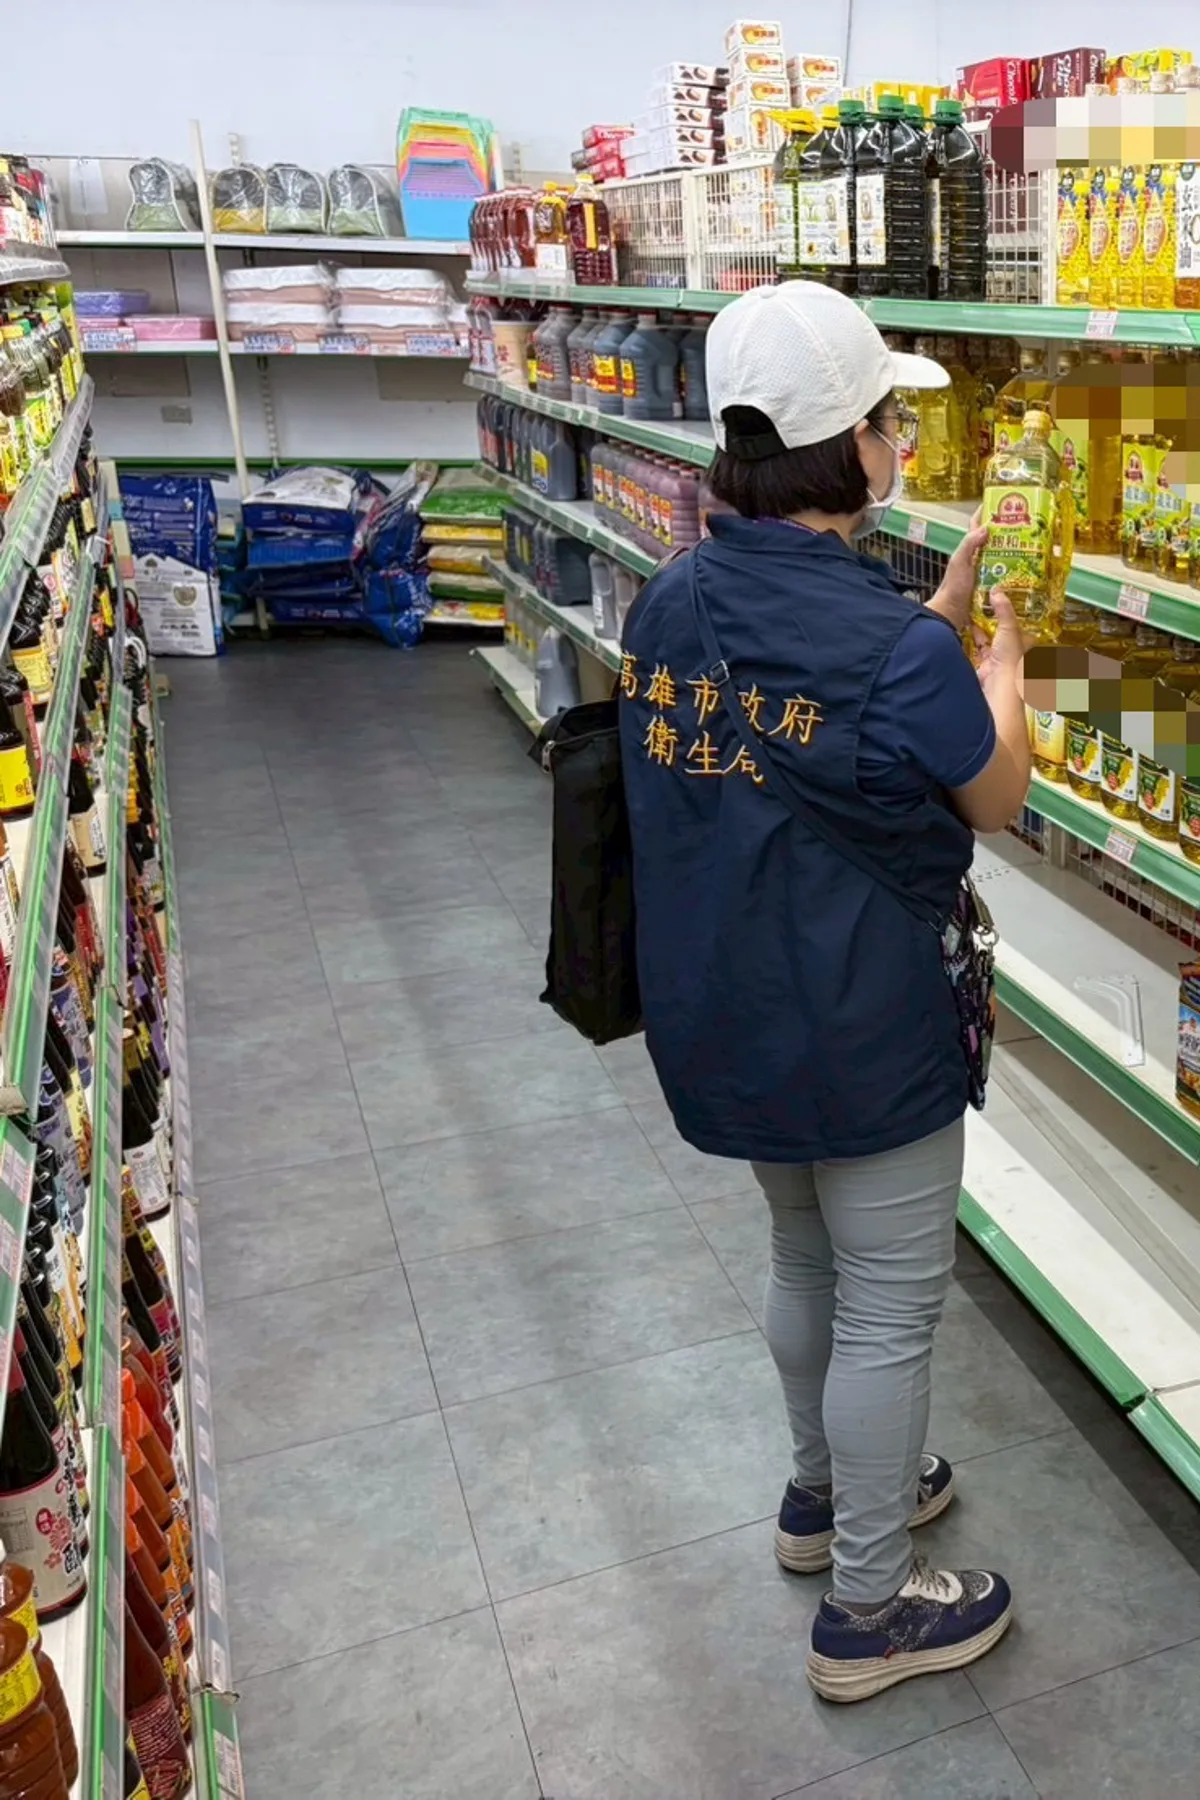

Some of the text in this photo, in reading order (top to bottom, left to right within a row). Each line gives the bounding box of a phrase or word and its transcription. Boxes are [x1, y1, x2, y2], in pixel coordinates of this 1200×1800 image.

[1180, 184, 1193, 269] 玄米油
[620, 650, 824, 744] 高雄市政府
